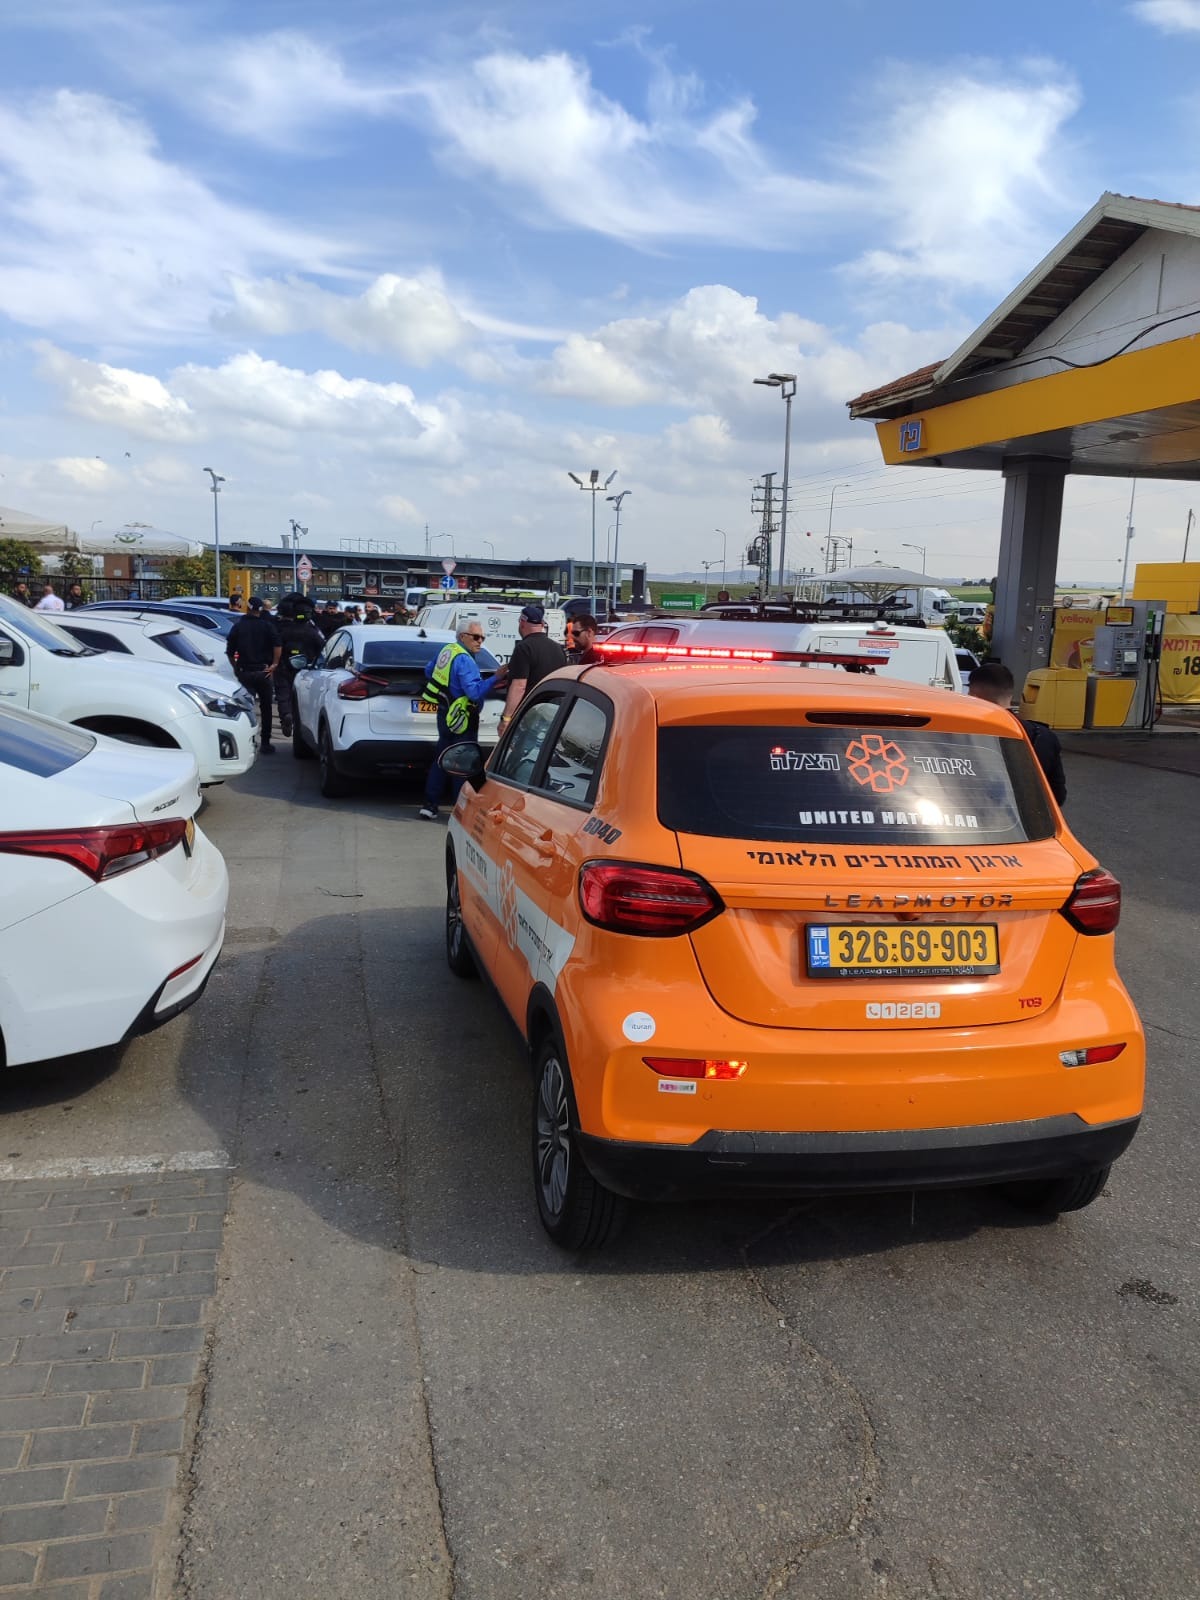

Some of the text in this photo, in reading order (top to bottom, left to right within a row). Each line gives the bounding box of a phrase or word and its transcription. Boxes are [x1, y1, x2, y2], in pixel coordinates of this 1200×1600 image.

[1061, 613, 1094, 625] yellow
[770, 750, 976, 776] איחוד הצלה
[799, 810, 978, 828] UNITED HATLAH
[583, 816, 623, 845] 6040
[747, 849, 1023, 873] ארגון המתנדבים הלאומי
[825, 894, 1014, 908] LEAPMOTOR
[814, 939, 827, 955] IL
[884, 1004, 937, 1016] 1221
[1018, 997, 1042, 1009] T03
[631, 1023, 652, 1031] ituran
